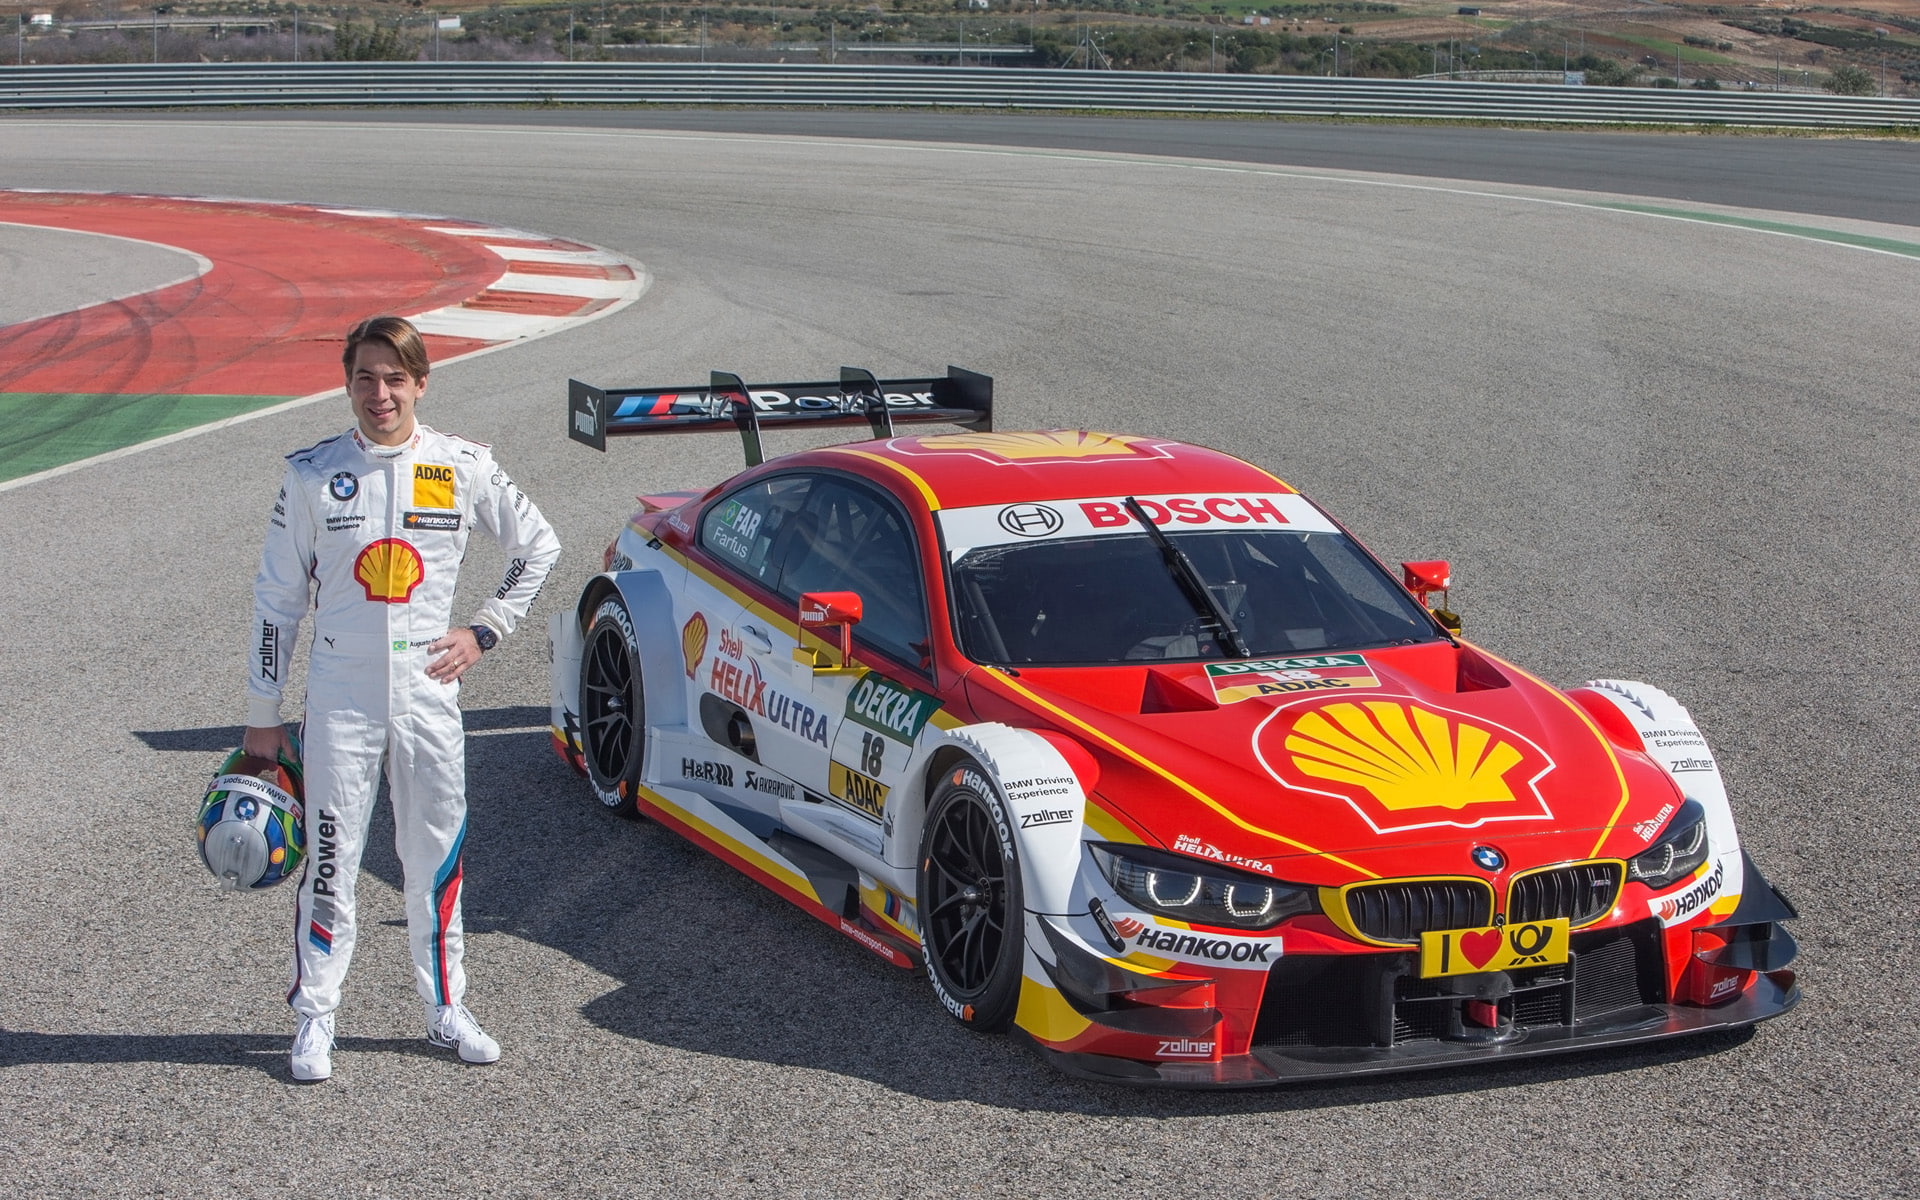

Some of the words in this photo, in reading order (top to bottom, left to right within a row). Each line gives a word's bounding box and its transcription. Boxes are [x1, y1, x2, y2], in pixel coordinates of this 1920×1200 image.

[414, 466, 452, 482] ADAC
[731, 504, 761, 540] FAR
[1079, 498, 1291, 528] BOSCH
[328, 523, 360, 532] Experience
[713, 526, 748, 558] Farfus
[495, 558, 527, 600] zollne
[800, 611, 824, 622] PUMA
[262, 619, 279, 683] zollner
[718, 628, 743, 661] Shell
[1214, 657, 1358, 674] DEKRA
[1257, 670, 1321, 683] 18
[1257, 679, 1350, 695] ADAC
[711, 656, 767, 717] HELIX
[767, 690, 829, 748] ULTRA
[854, 679, 922, 737] DEKRA
[1642, 730, 1668, 739] BMW
[1668, 729, 1701, 738] Driving
[1655, 739, 1705, 748] Experience
[861, 731, 885, 778] 18
[1671, 758, 1713, 773] zollner
[682, 757, 714, 781] H&R
[224, 776, 266, 792] Motorsport
[845, 769, 883, 814] ADAC
[1004, 778, 1034, 791] BMW
[1036, 775, 1074, 787] Driving
[1008, 787, 1068, 801] Experience
[265, 787, 288, 804] BMW
[1021, 810, 1074, 829] zollner
[1656, 803, 1675, 827] ULTRA
[1177, 834, 1201, 845] Shell
[313, 809, 336, 897] Power
[1173, 841, 1225, 861] HELIX
[1225, 854, 1274, 874] ULTRA
[841, 919, 894, 960] bmw-motorsport.com
[1441, 934, 1450, 974] I
[1710, 976, 1739, 999] zollner
[1155, 1039, 1216, 1058] zollner
